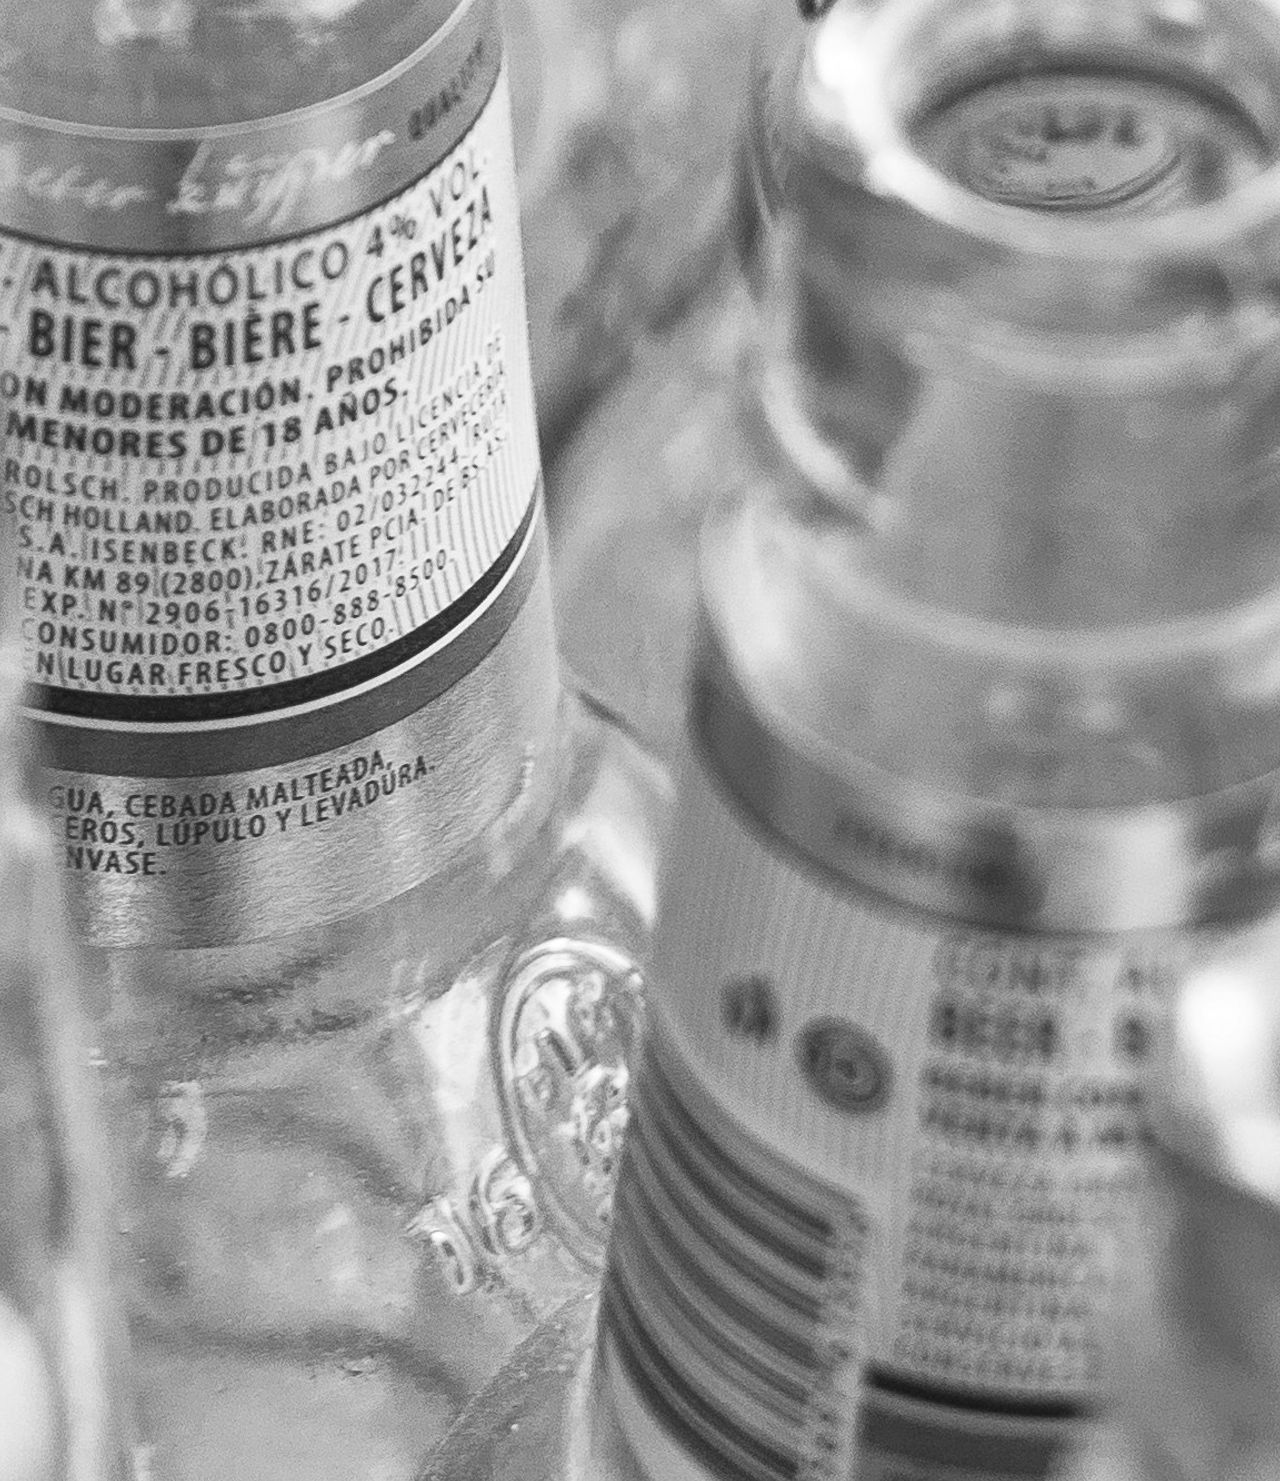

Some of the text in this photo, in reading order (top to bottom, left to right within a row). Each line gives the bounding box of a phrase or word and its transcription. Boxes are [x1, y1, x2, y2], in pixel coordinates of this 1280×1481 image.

[366, 214, 417, 258] 4%
[29, 185, 492, 371] BIER BIÈRE CERVEZA
[326, 285, 471, 394] PROHIBIDA
[5, 377, 410, 459] MENORES DE 18 AÑOS.
[143, 462, 312, 503] PRODUCIDA
[324, 431, 386, 476] BAJO
[209, 475, 362, 532] ELABORADA
[370, 450, 411, 490] POR
[64, 565, 106, 591] KM
[115, 570, 151, 594] 89
[264, 535, 361, 585] ZÁRATE
[66, 616, 396, 687] LUGAR FRESCO Y SECO.
[49, 749, 394, 819] GUA, CEBADA MALTEADA,
[156, 813, 267, 847] LÚPULO
[274, 807, 293, 833] Y
[300, 754, 438, 829] LEVADURA.
[66, 845, 167, 877] NVASE.
